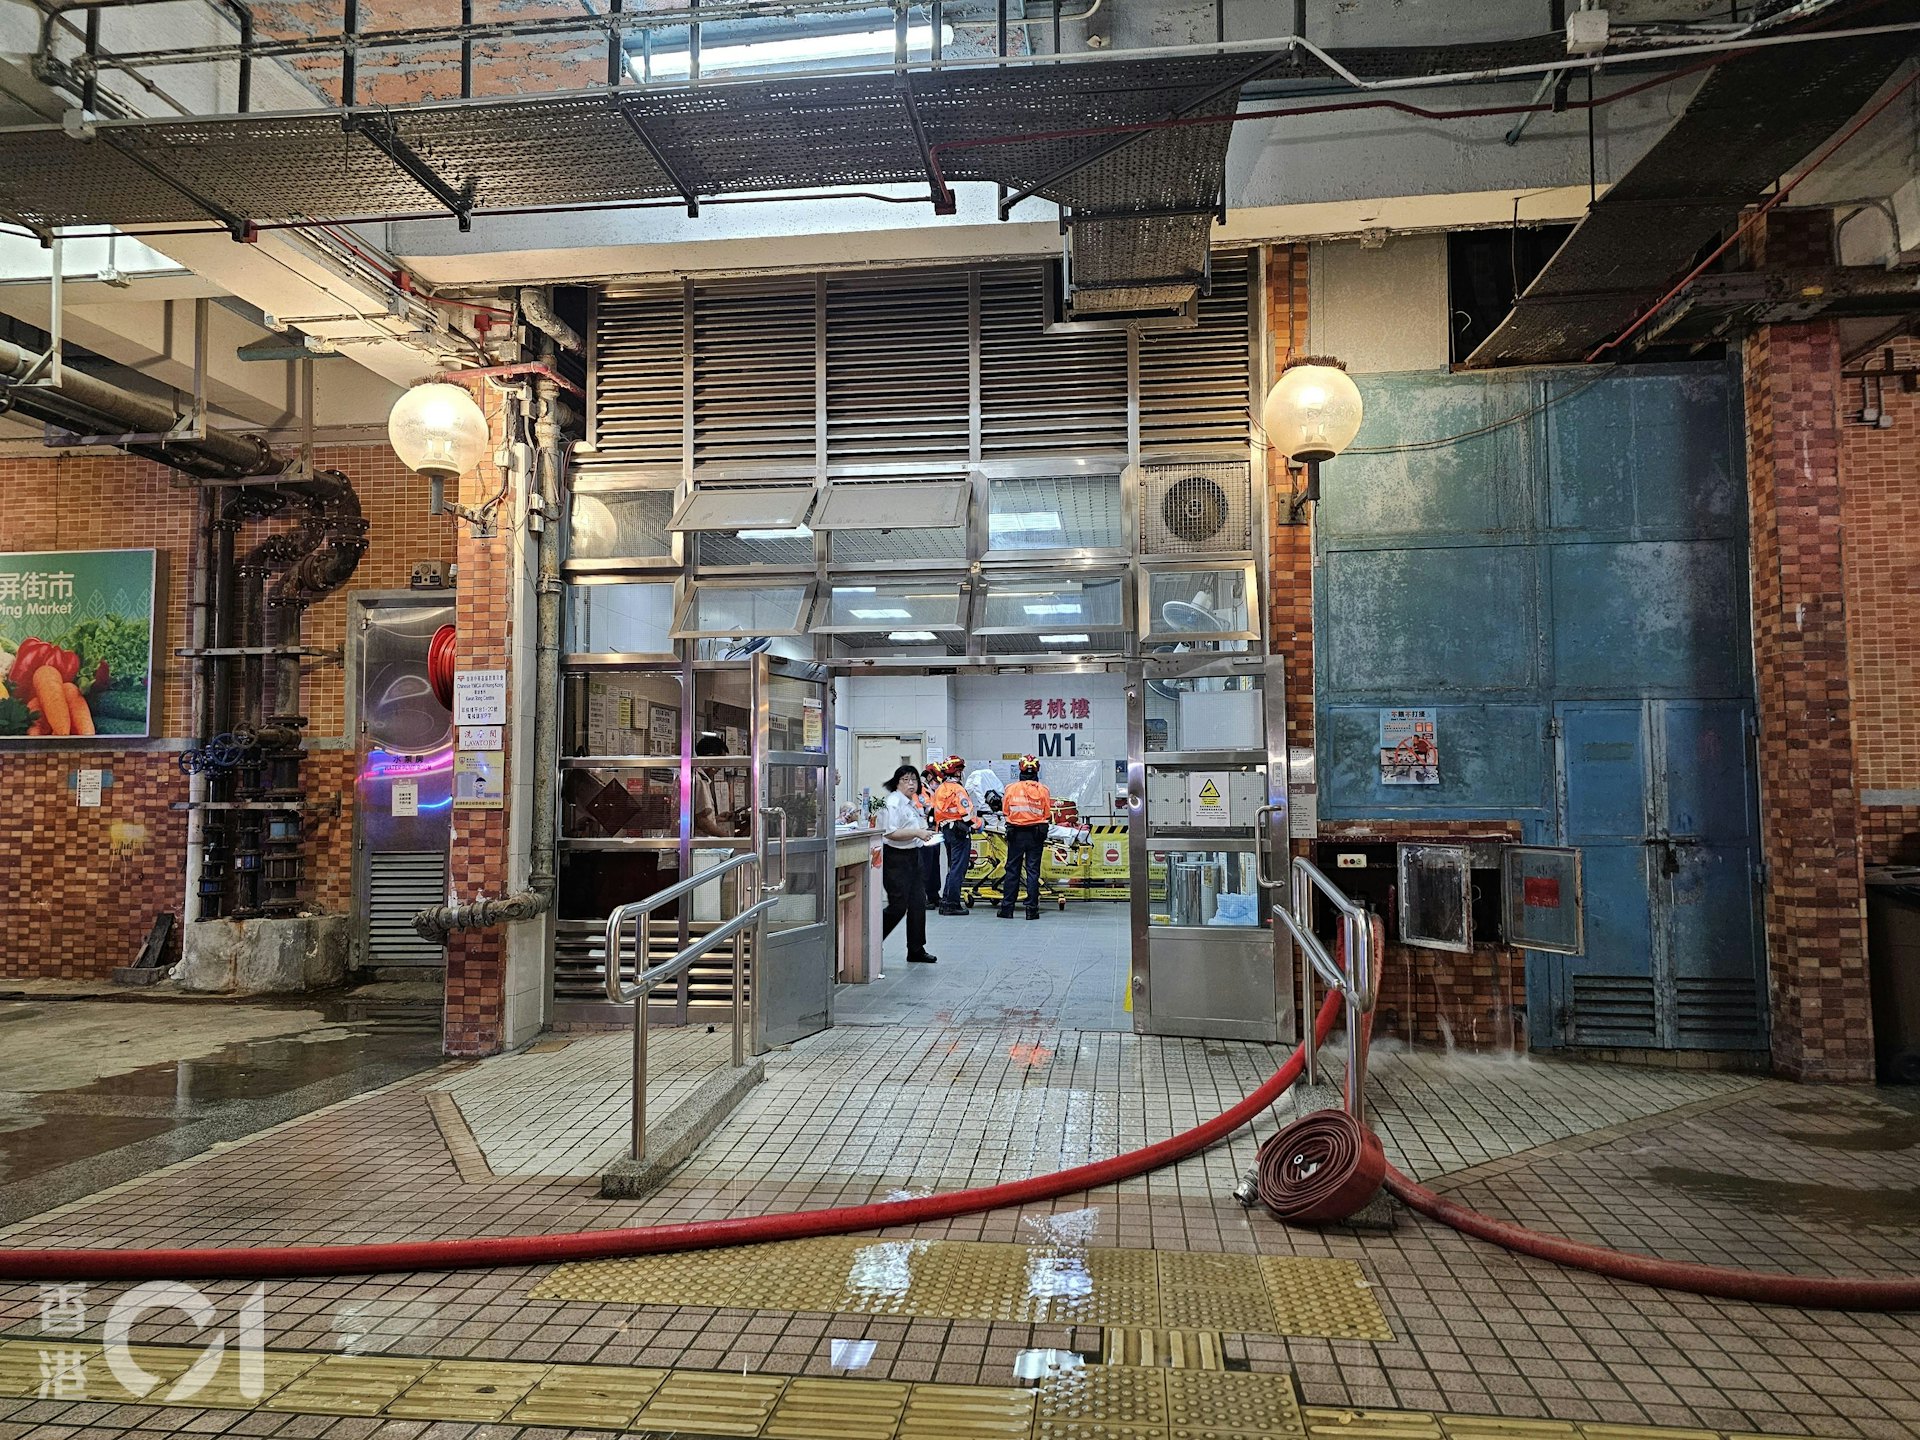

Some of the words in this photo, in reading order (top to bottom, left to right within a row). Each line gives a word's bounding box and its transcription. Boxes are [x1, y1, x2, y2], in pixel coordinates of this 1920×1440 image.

[0, 570, 75, 601] 屏街市
[26, 602, 73, 615] Market
[1024, 697, 1091, 720] 翠桃樓
[1038, 733, 1076, 757] M1
